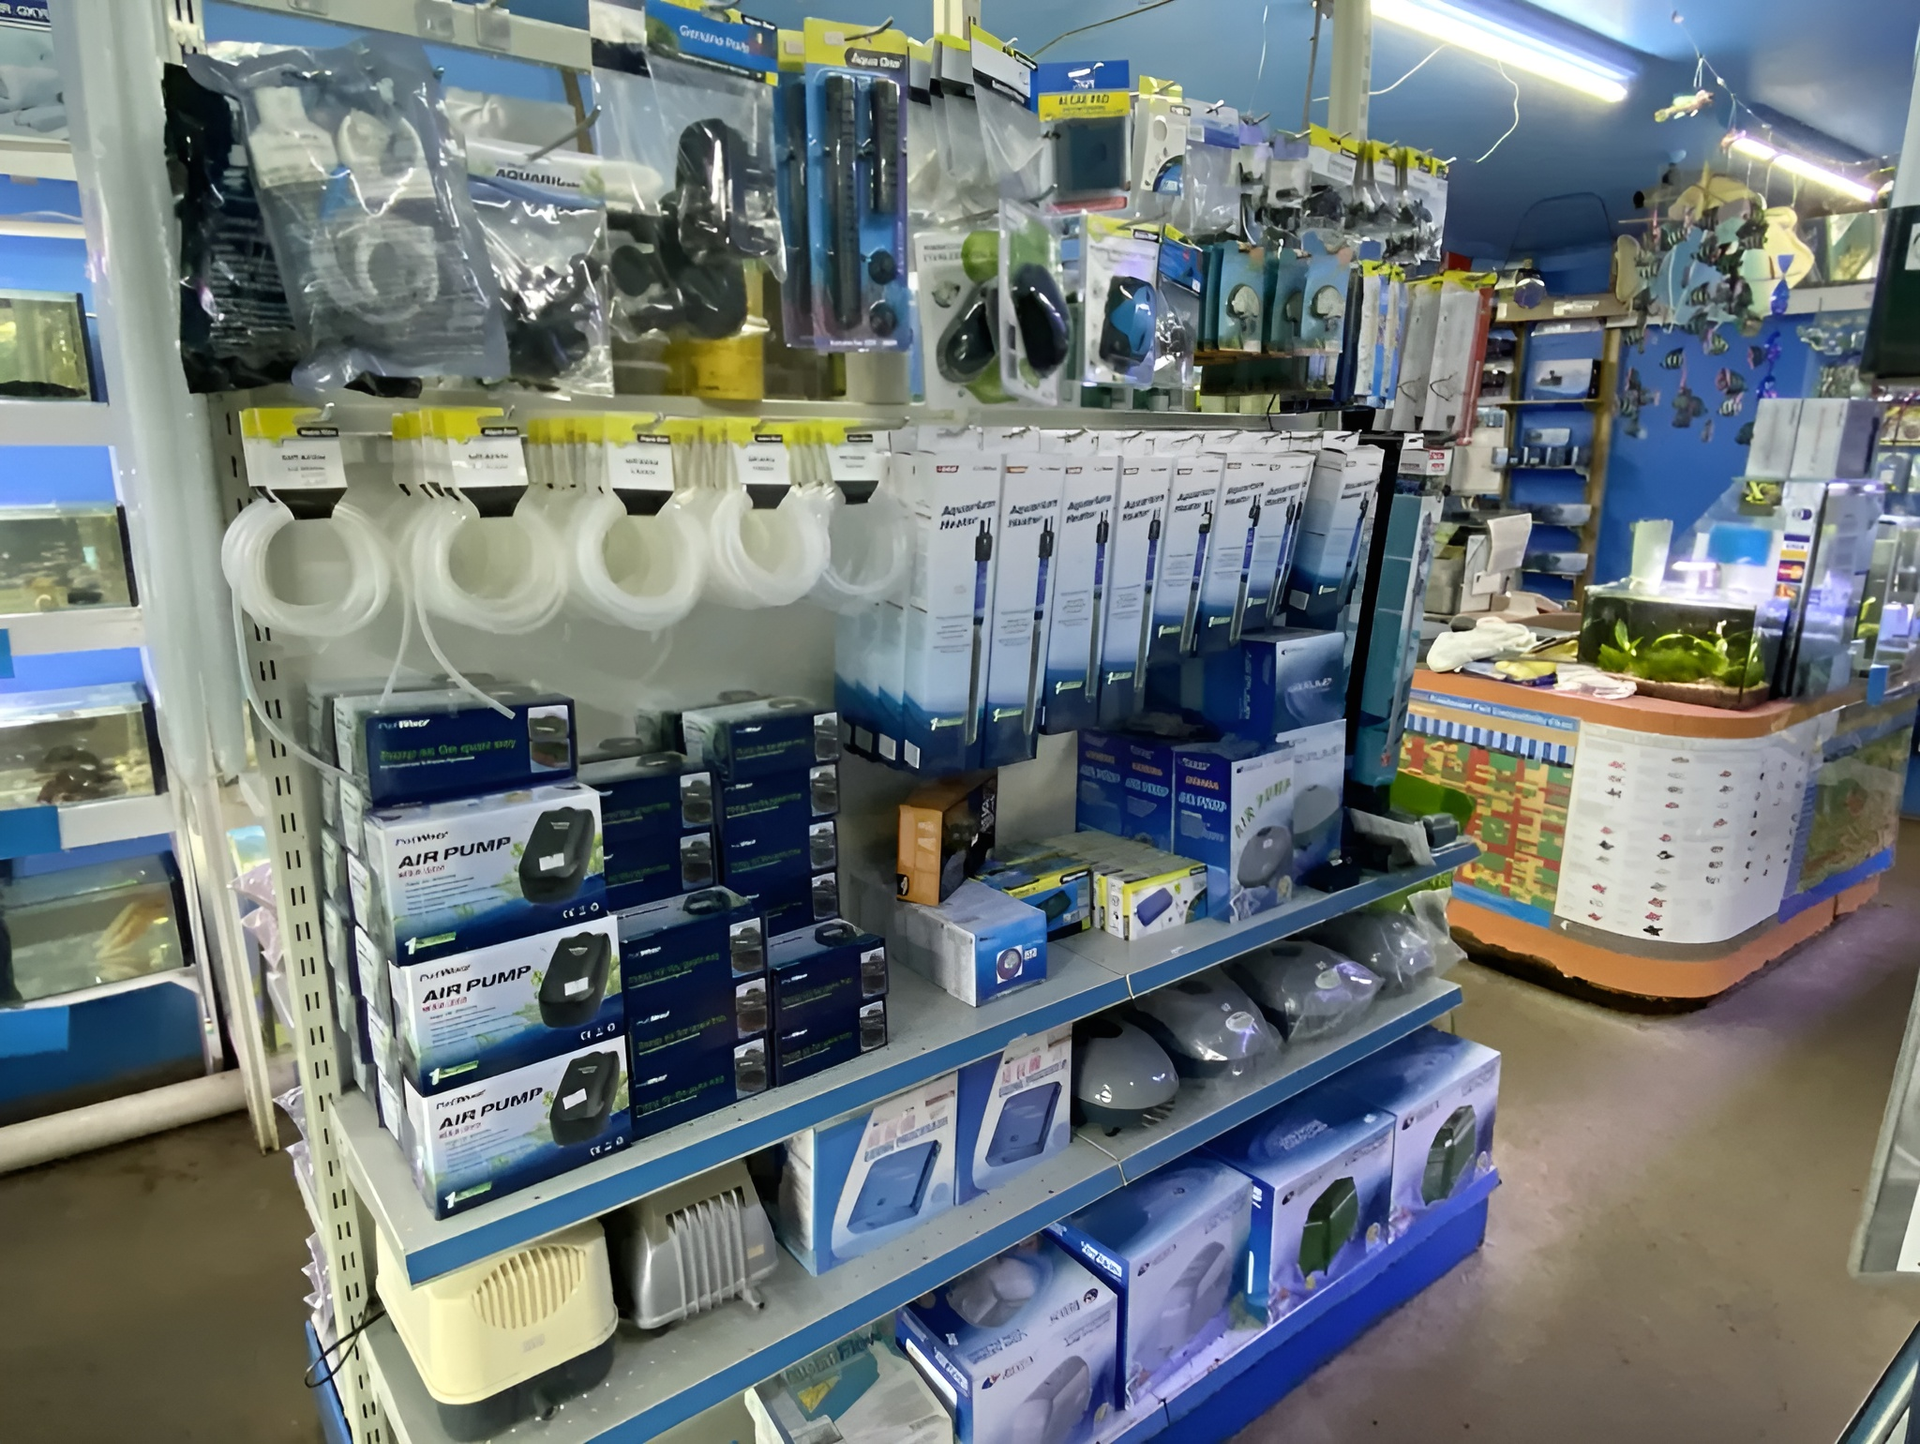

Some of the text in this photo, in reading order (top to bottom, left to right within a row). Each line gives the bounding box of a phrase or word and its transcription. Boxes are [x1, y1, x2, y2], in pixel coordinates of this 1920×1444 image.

[851, 53, 878, 67] Aqua
[398, 837, 511, 869] AIR PUMP
[422, 983, 462, 1004] AIR
[466, 965, 532, 992] PUMP
[439, 1109, 476, 1131] AIR
[481, 1087, 543, 1117] PUMP
